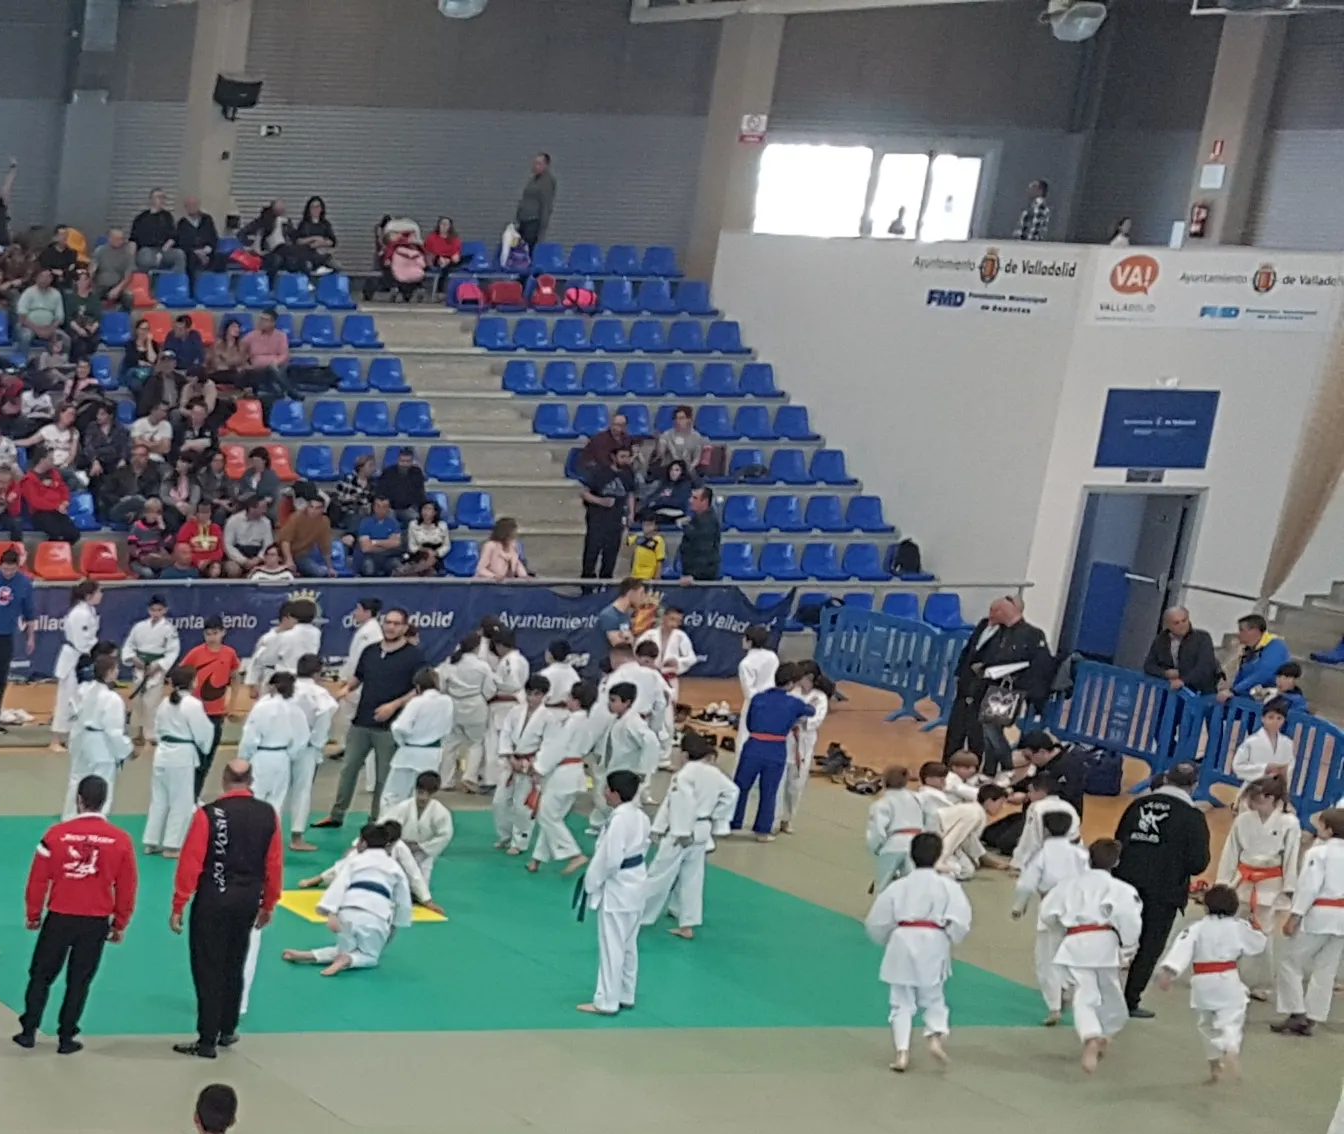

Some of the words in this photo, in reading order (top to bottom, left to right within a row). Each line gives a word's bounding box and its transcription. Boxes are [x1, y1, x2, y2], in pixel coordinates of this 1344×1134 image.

[1004, 260, 1018, 273] de
[1022, 260, 1076, 278] Valladolid
[1115, 265, 1151, 288] VA!
[1282, 274, 1296, 285] de
[926, 289, 966, 307] FMD
[498, 611, 599, 630] Ayuntamient
